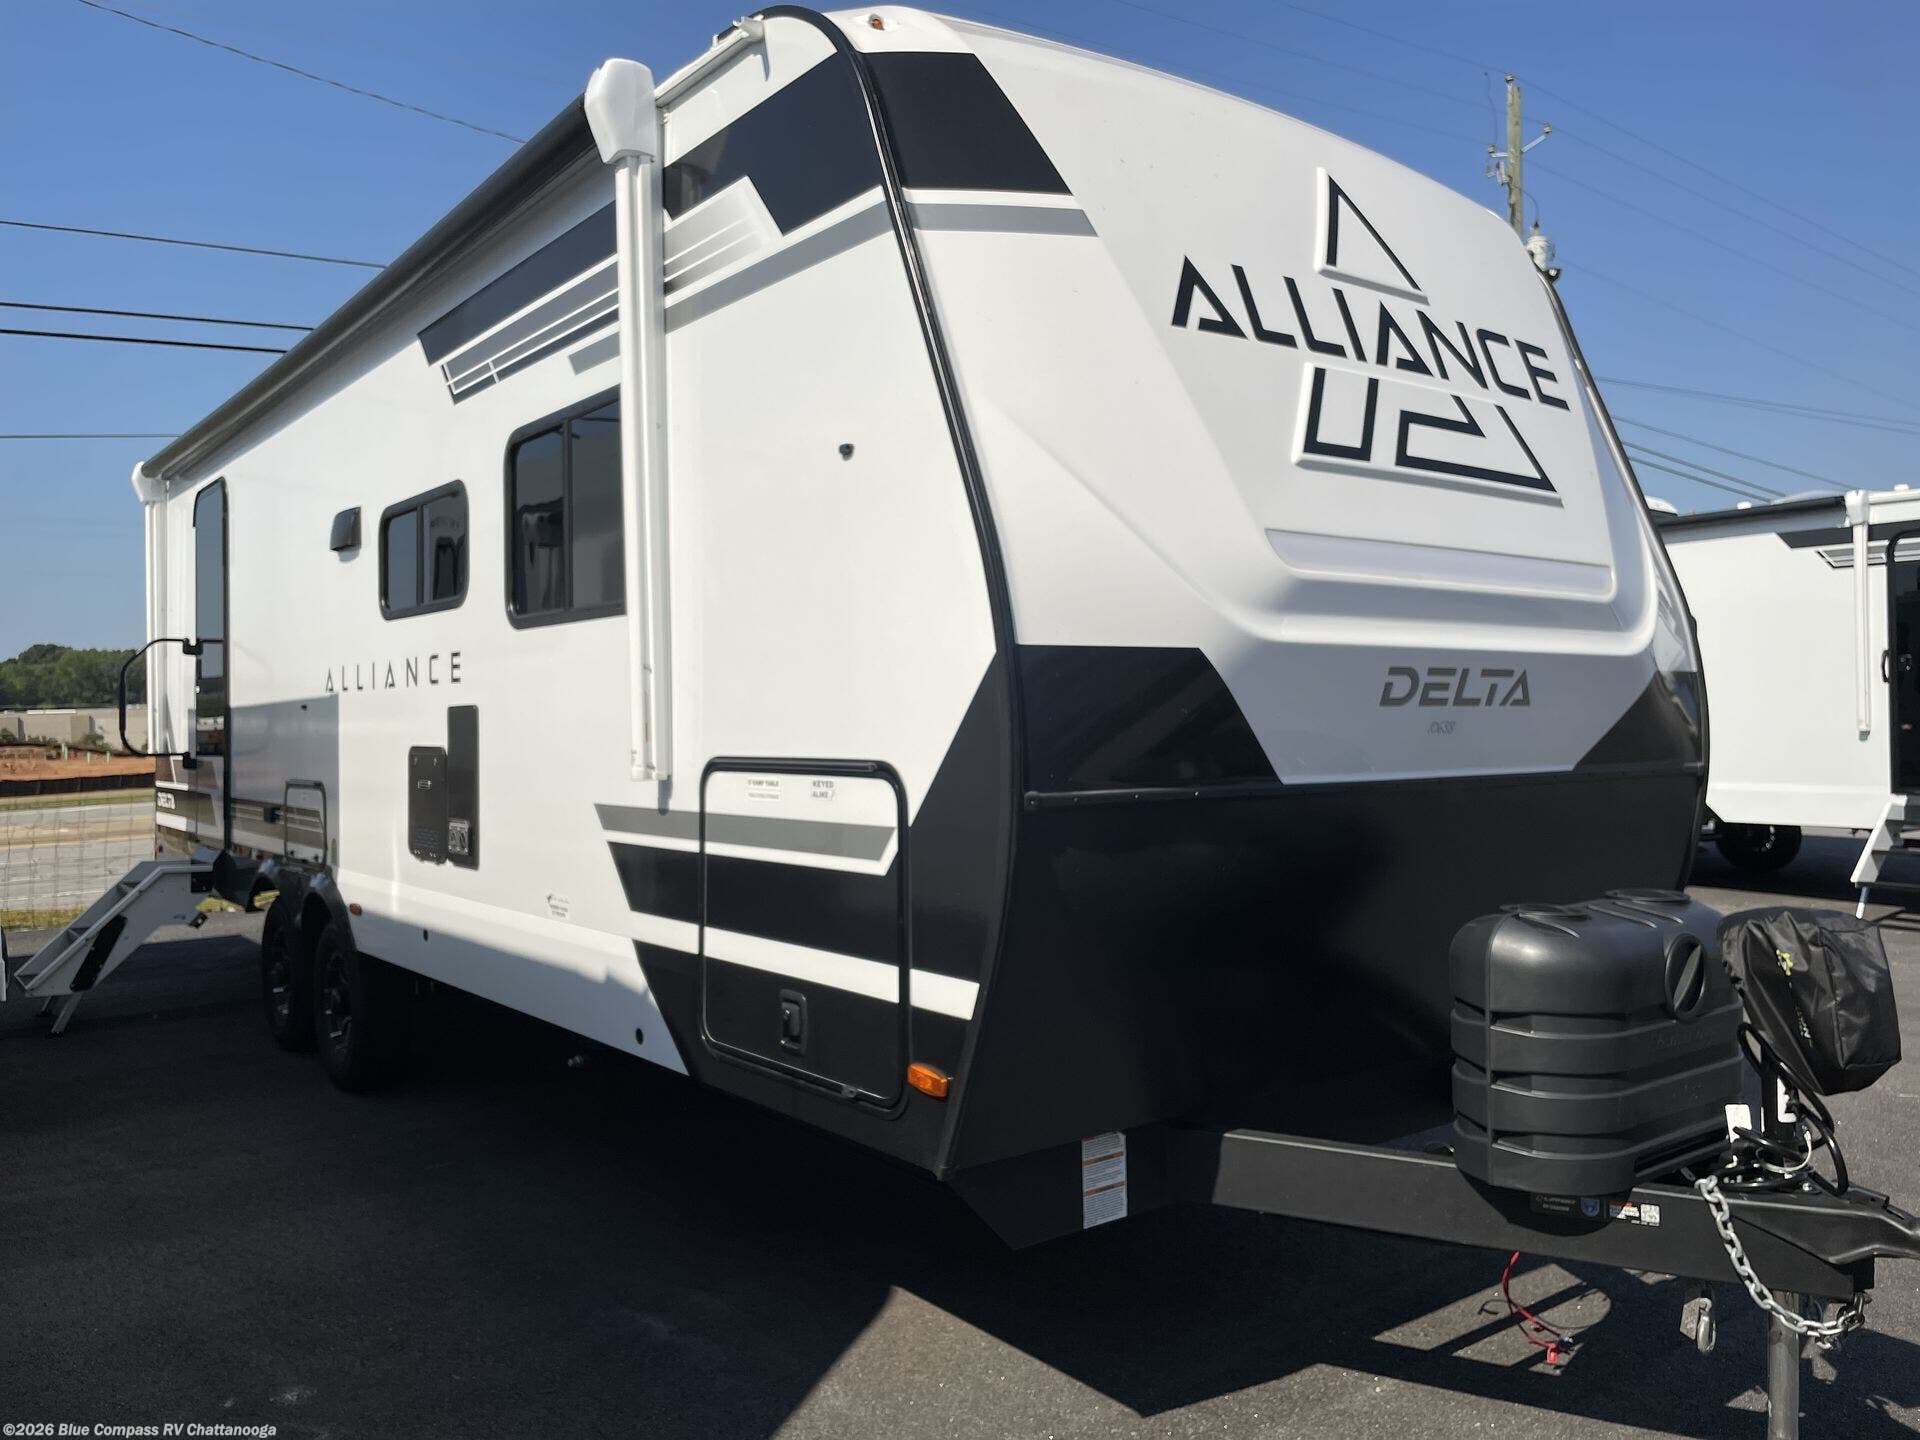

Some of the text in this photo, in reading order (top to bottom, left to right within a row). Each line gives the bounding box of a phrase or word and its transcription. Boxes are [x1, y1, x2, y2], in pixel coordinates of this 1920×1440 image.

[1171, 255, 1569, 411] ALLIANCE
[326, 652, 461, 692] ALLIANCE
[1379, 666, 1531, 707] DELTA
